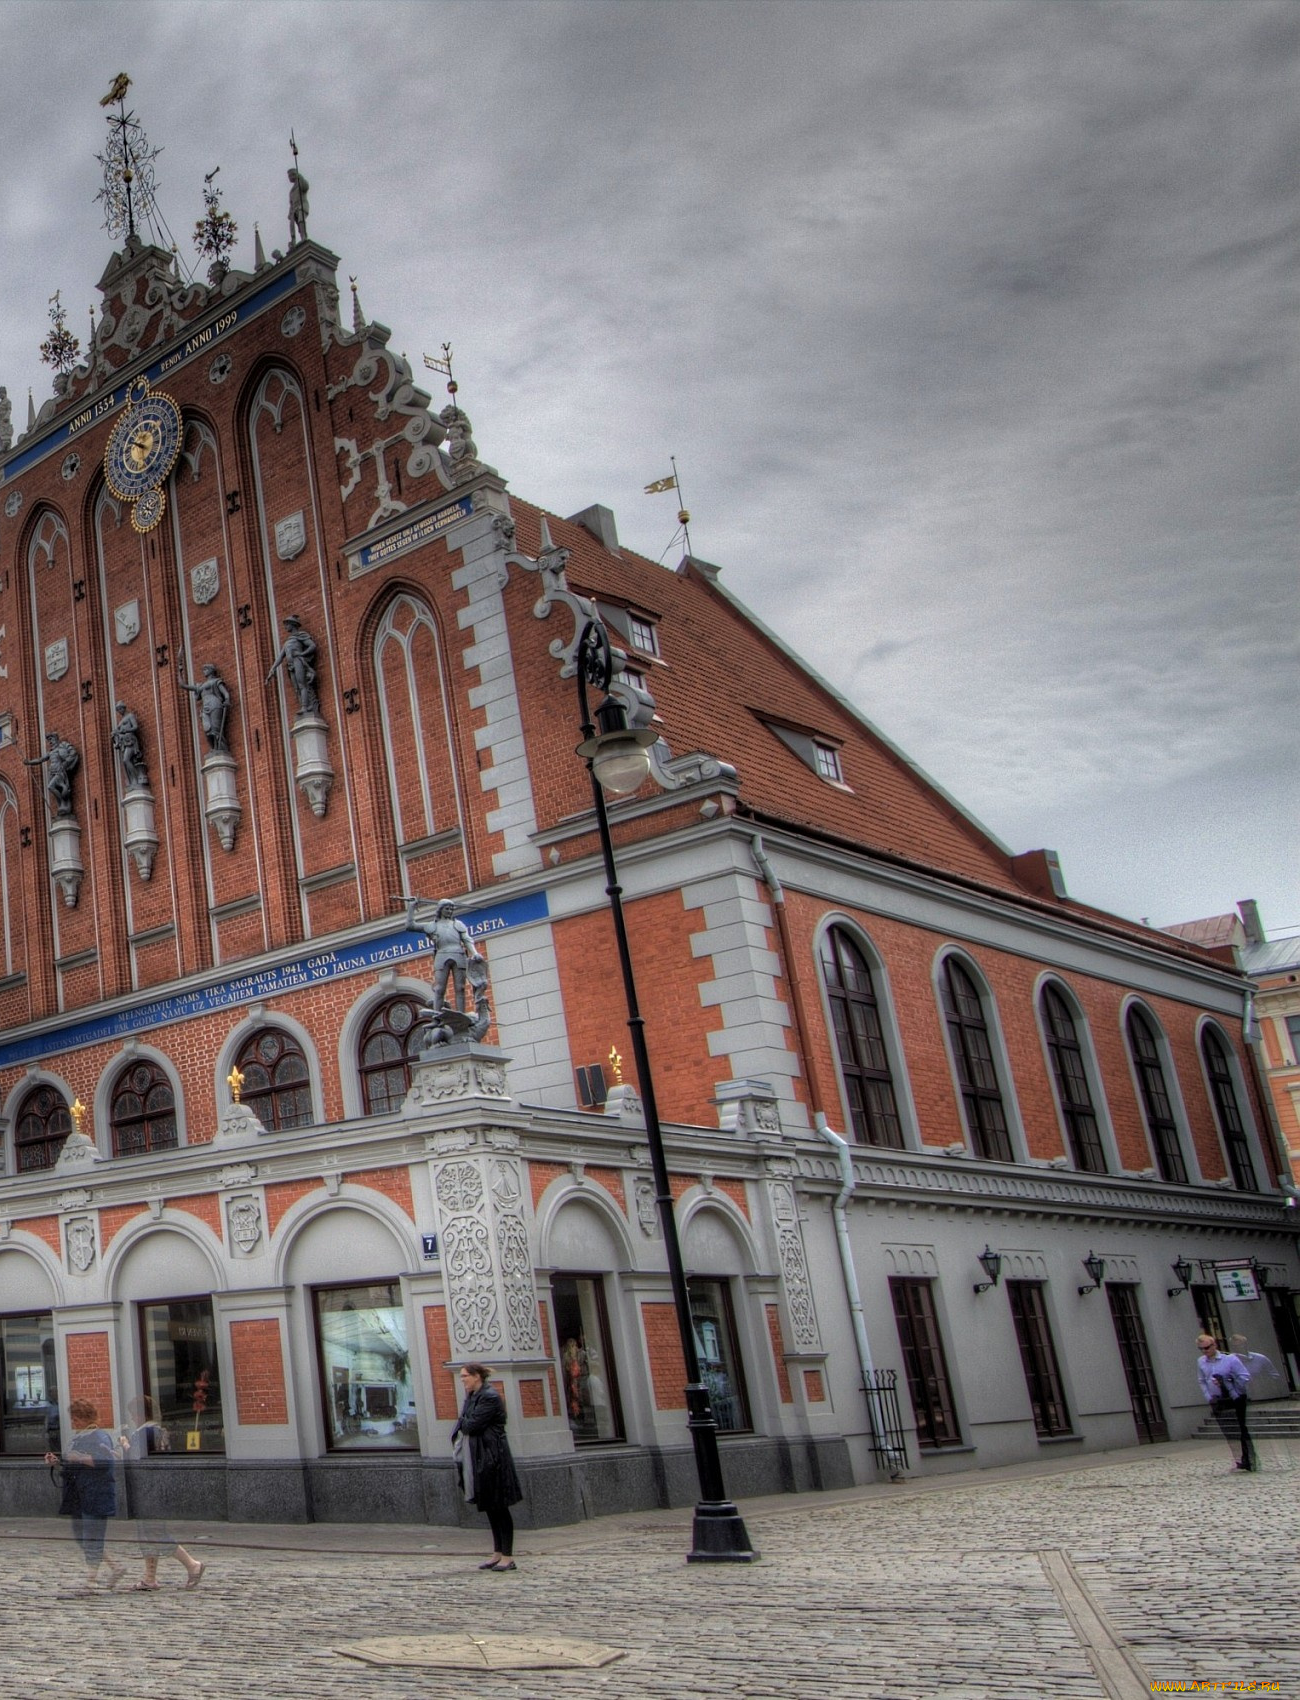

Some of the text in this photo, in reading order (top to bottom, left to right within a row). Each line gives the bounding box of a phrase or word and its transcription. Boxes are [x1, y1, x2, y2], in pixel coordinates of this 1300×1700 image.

[185, 328, 212, 356] ANNO
[215, 310, 238, 335] 1999
[69, 394, 115, 435] ANNO 1334
[114, 1023, 128, 1033] PAR
[133, 1015, 158, 1028] GODU
[161, 1005, 187, 1020] NAMU
[192, 1001, 204, 1011] UZ
[209, 987, 254, 1007] VECAJIEM
[257, 972, 307, 994] PAMATIEM
[312, 967, 327, 979] NO
[332, 956, 366, 975] JAUNA
[176, 992, 200, 1006] NAMS
[204, 984, 226, 998] TIKA
[230, 970, 277, 990] SAGRAUTS
[281, 964, 303, 977] 1941.
[426, 1239, 432, 1250] 7
